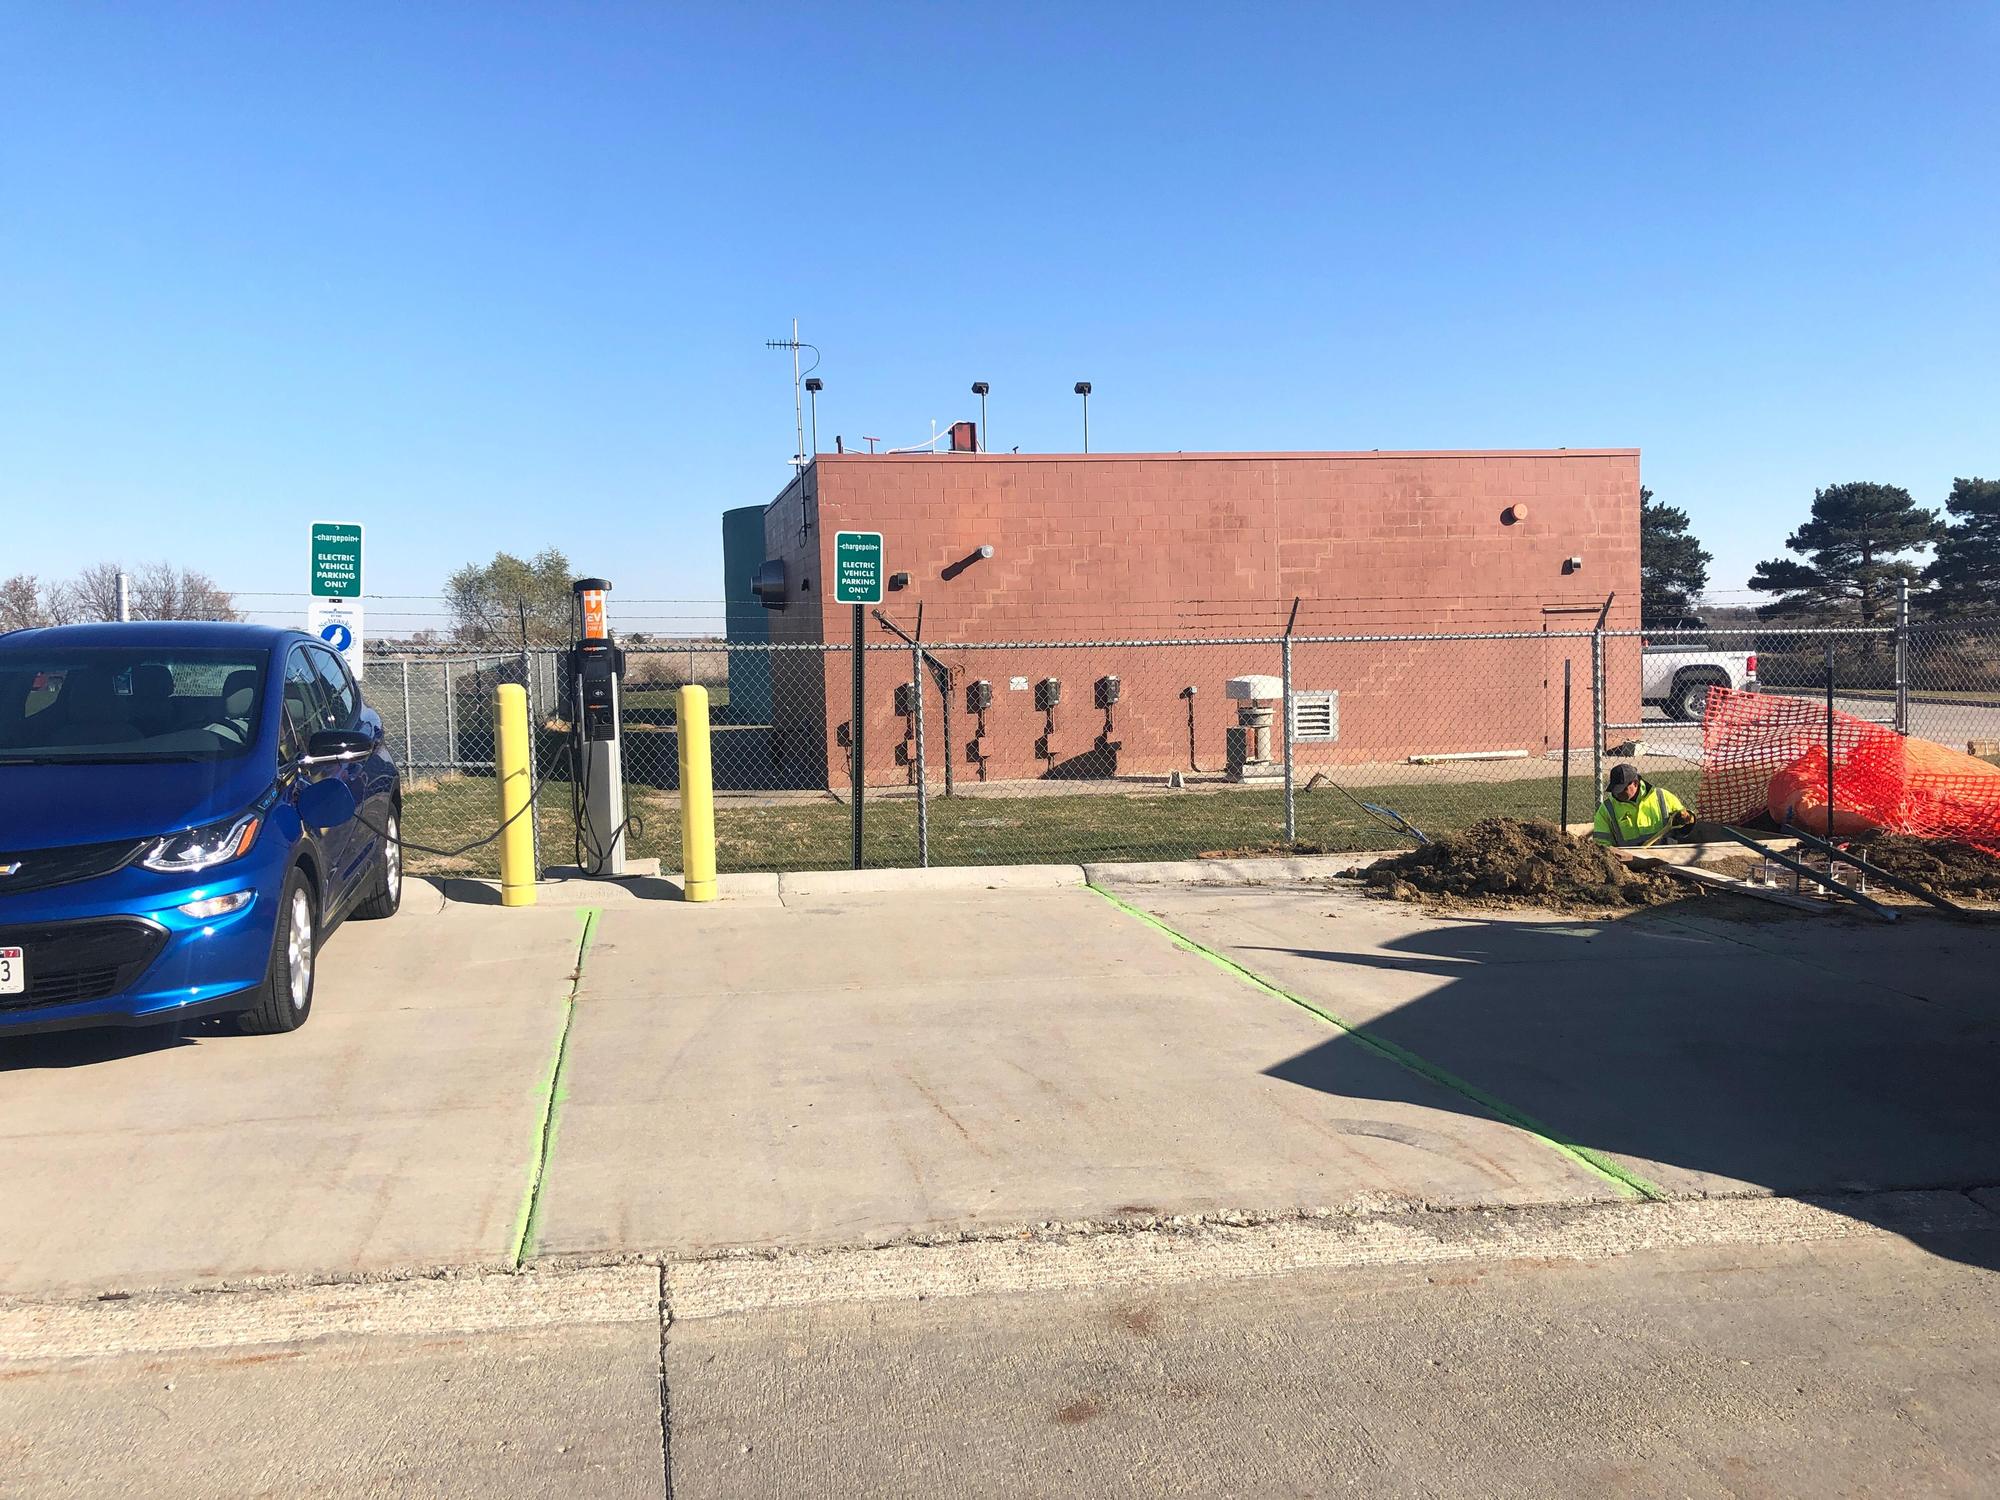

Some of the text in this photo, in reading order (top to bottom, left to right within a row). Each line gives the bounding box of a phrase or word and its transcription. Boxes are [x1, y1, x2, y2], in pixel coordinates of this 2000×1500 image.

[318, 553, 355, 562] ELECTRIC
[319, 562, 354, 571] VEHICLE
[842, 561, 876, 569] ELECTRIC
[316, 571, 356, 580] PARKING
[324, 580, 348, 588] ONLY
[841, 578, 876, 586] PARKING
[848, 586, 869, 594] ONLY
[587, 612, 602, 622] EV
[0, 960, 11, 982] 3
